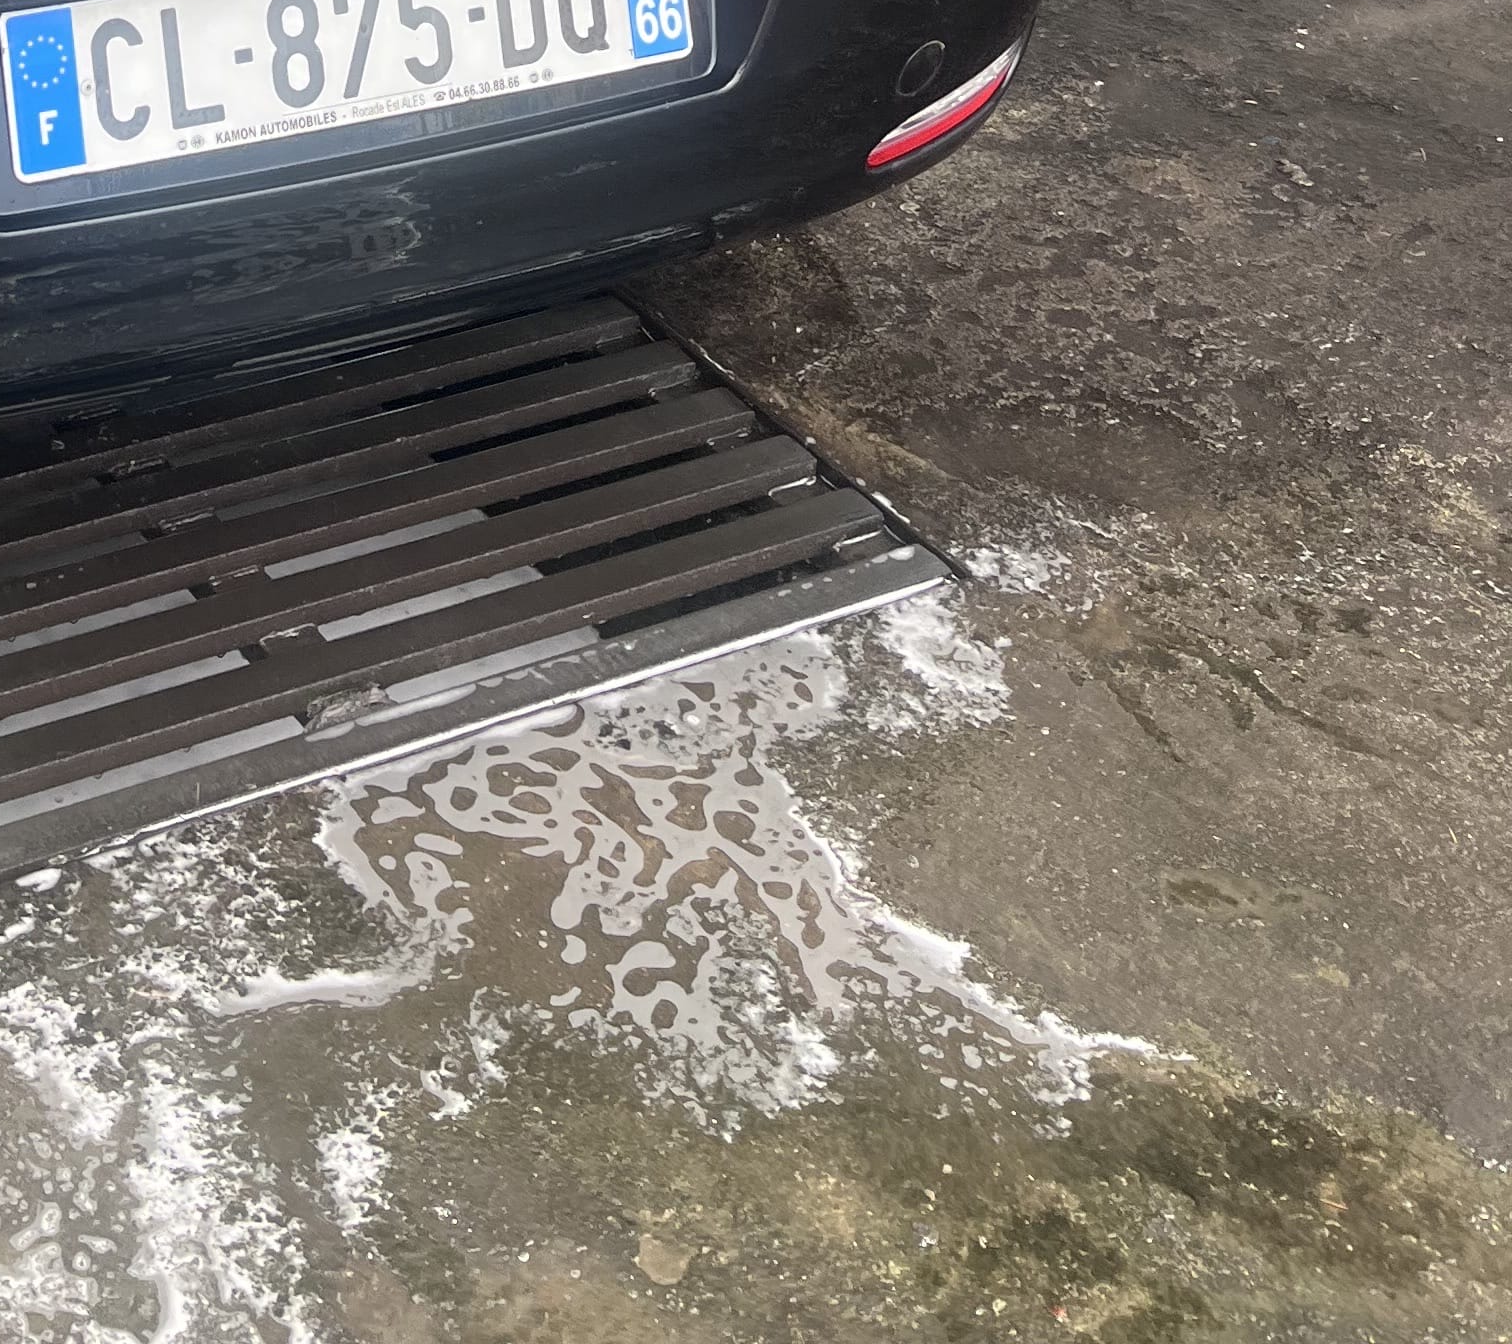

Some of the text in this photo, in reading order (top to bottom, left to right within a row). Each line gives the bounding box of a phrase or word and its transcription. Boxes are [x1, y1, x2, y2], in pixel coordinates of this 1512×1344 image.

[39, 110, 58, 145] F
[215, 127, 257, 144] KAMON
[259, 111, 337, 137] AUTOMOBILES
[352, 102, 384, 119] Rocade
